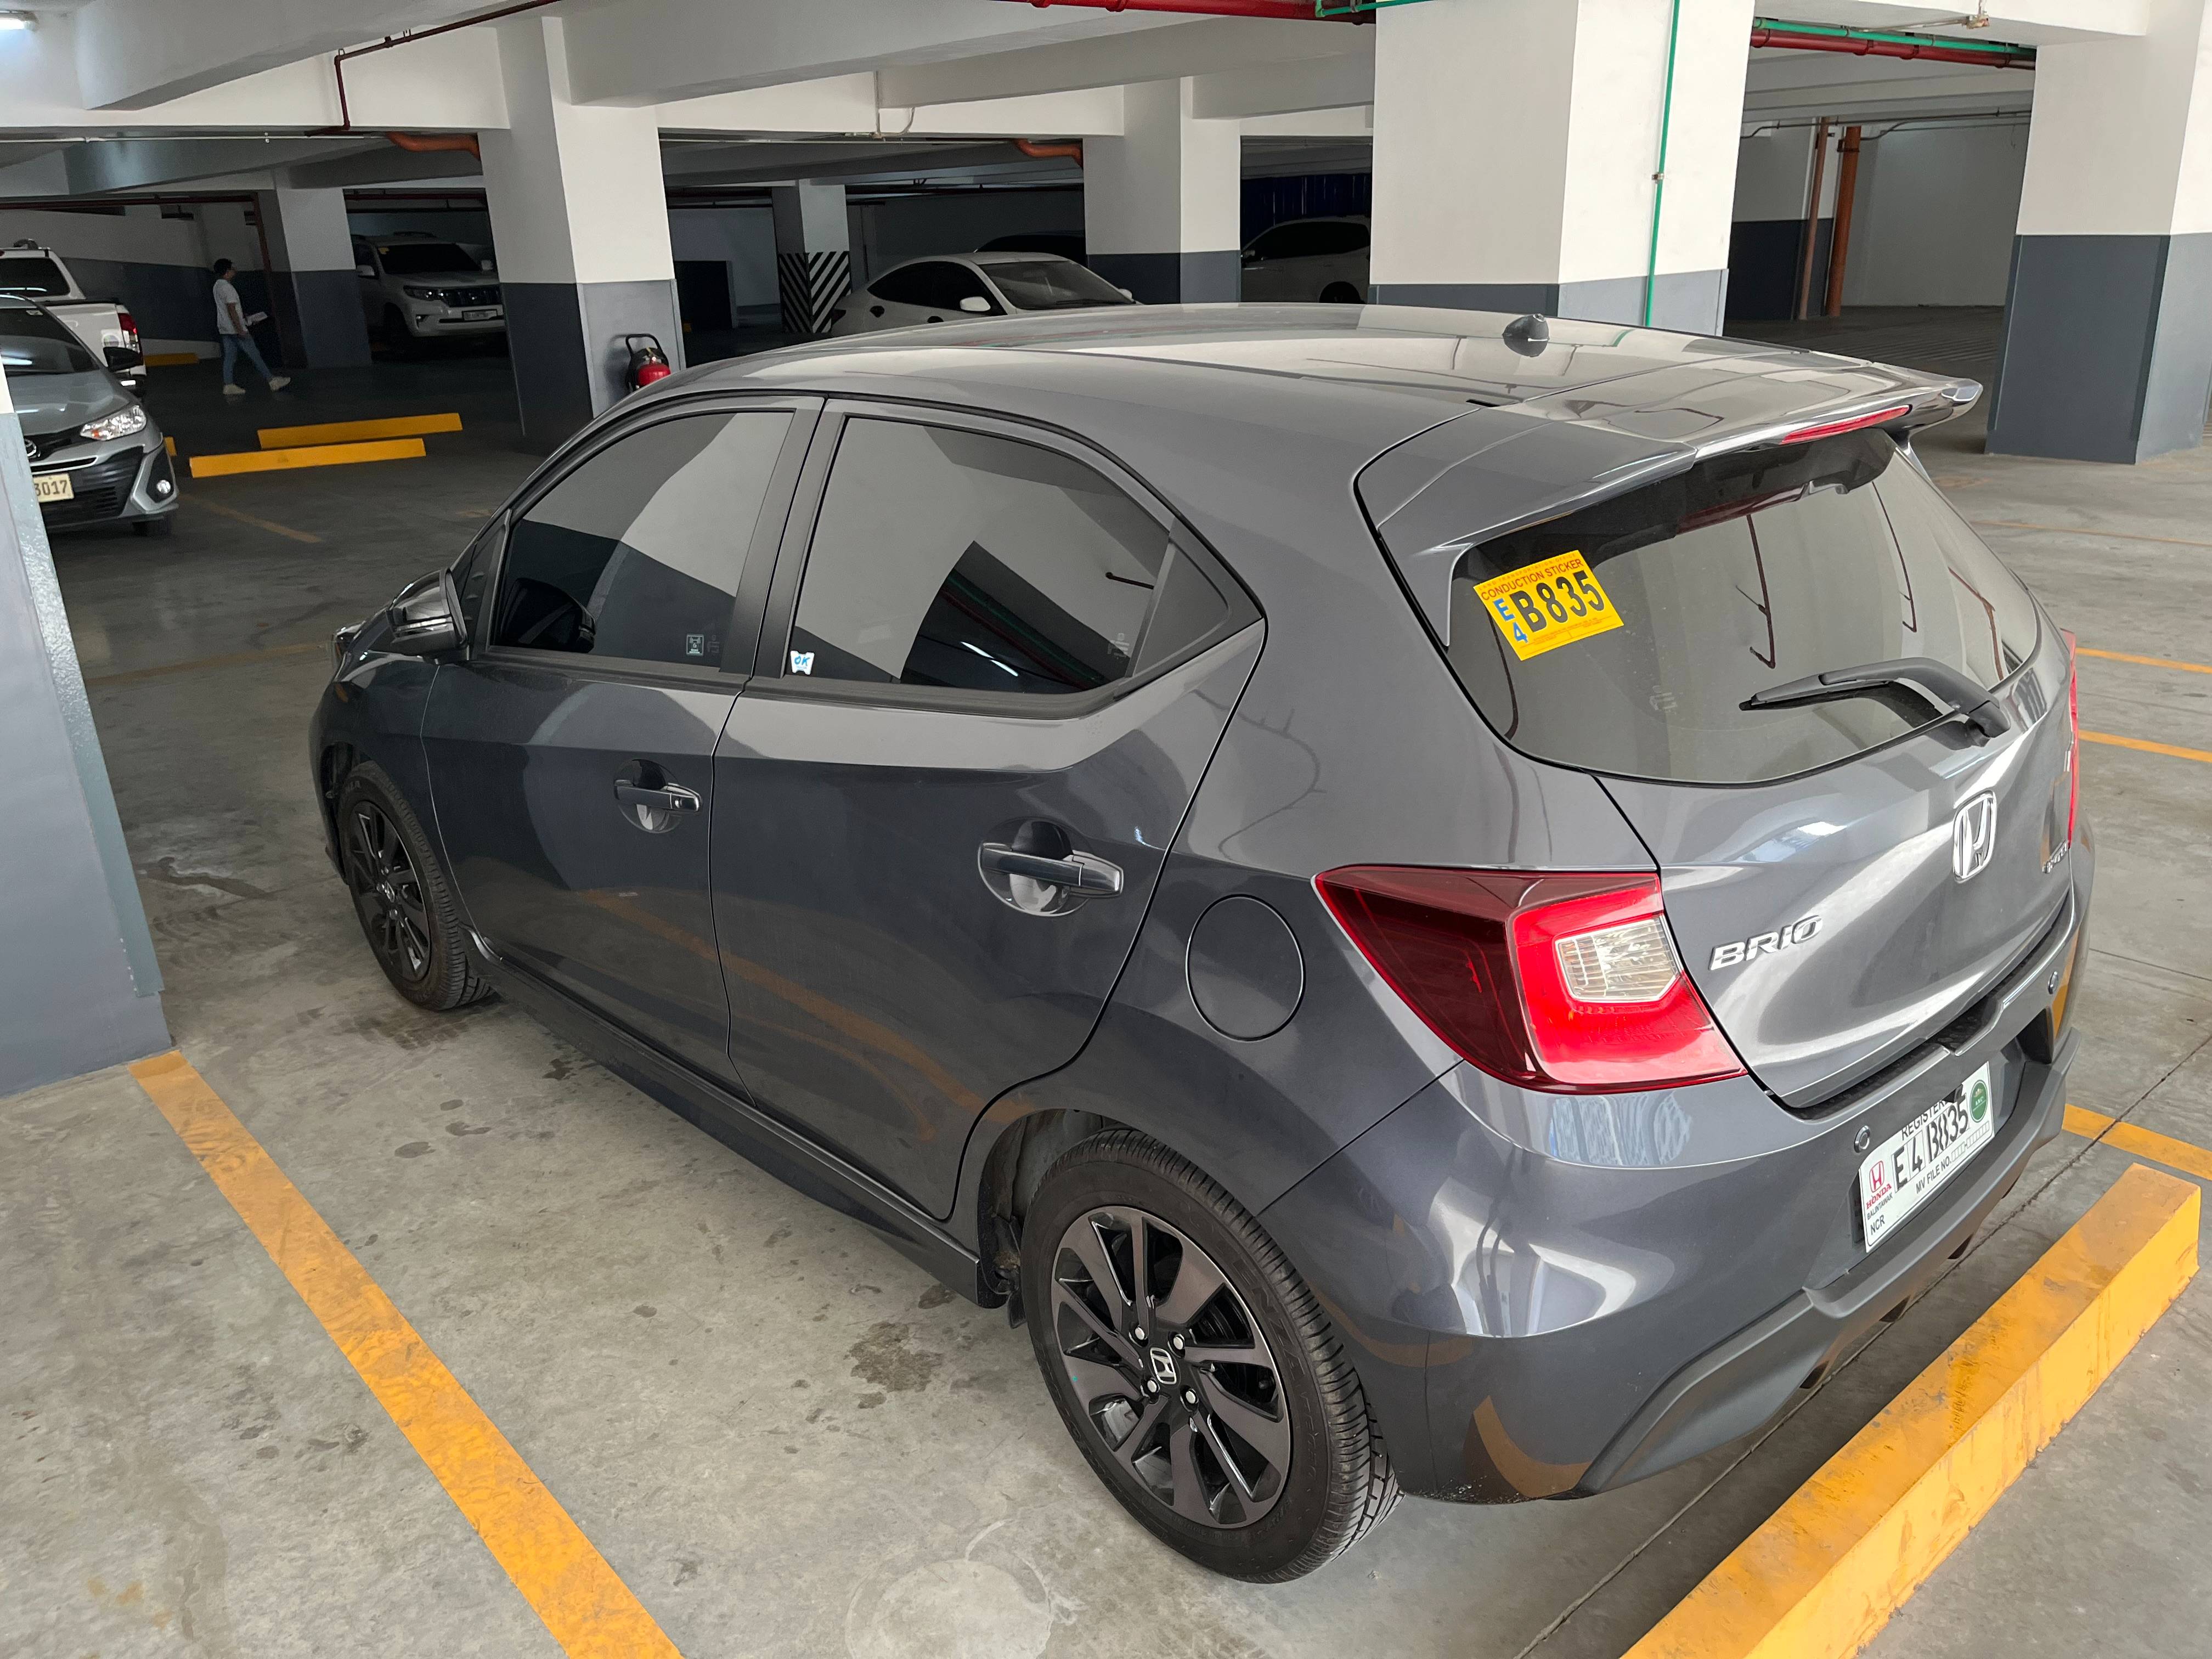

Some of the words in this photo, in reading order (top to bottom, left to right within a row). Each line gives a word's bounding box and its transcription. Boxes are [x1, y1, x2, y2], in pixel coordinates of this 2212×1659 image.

[1481, 571, 1545, 601] CONDUCTION
[1545, 558, 1584, 577] STICKER
[1509, 570, 1604, 632] B835
[1708, 915, 1823, 971] BRIO
[1901, 1101, 1948, 1141] REGISTER
[1916, 1177, 1925, 1194] MV
[1927, 1164, 1940, 1184] FILE
[1941, 1156, 1951, 1171] NO.
[1866, 1183, 1892, 1209] HONDA
[1867, 1192, 1893, 1220] BALINTAWAK
[1870, 1215, 1885, 1235] NCR
